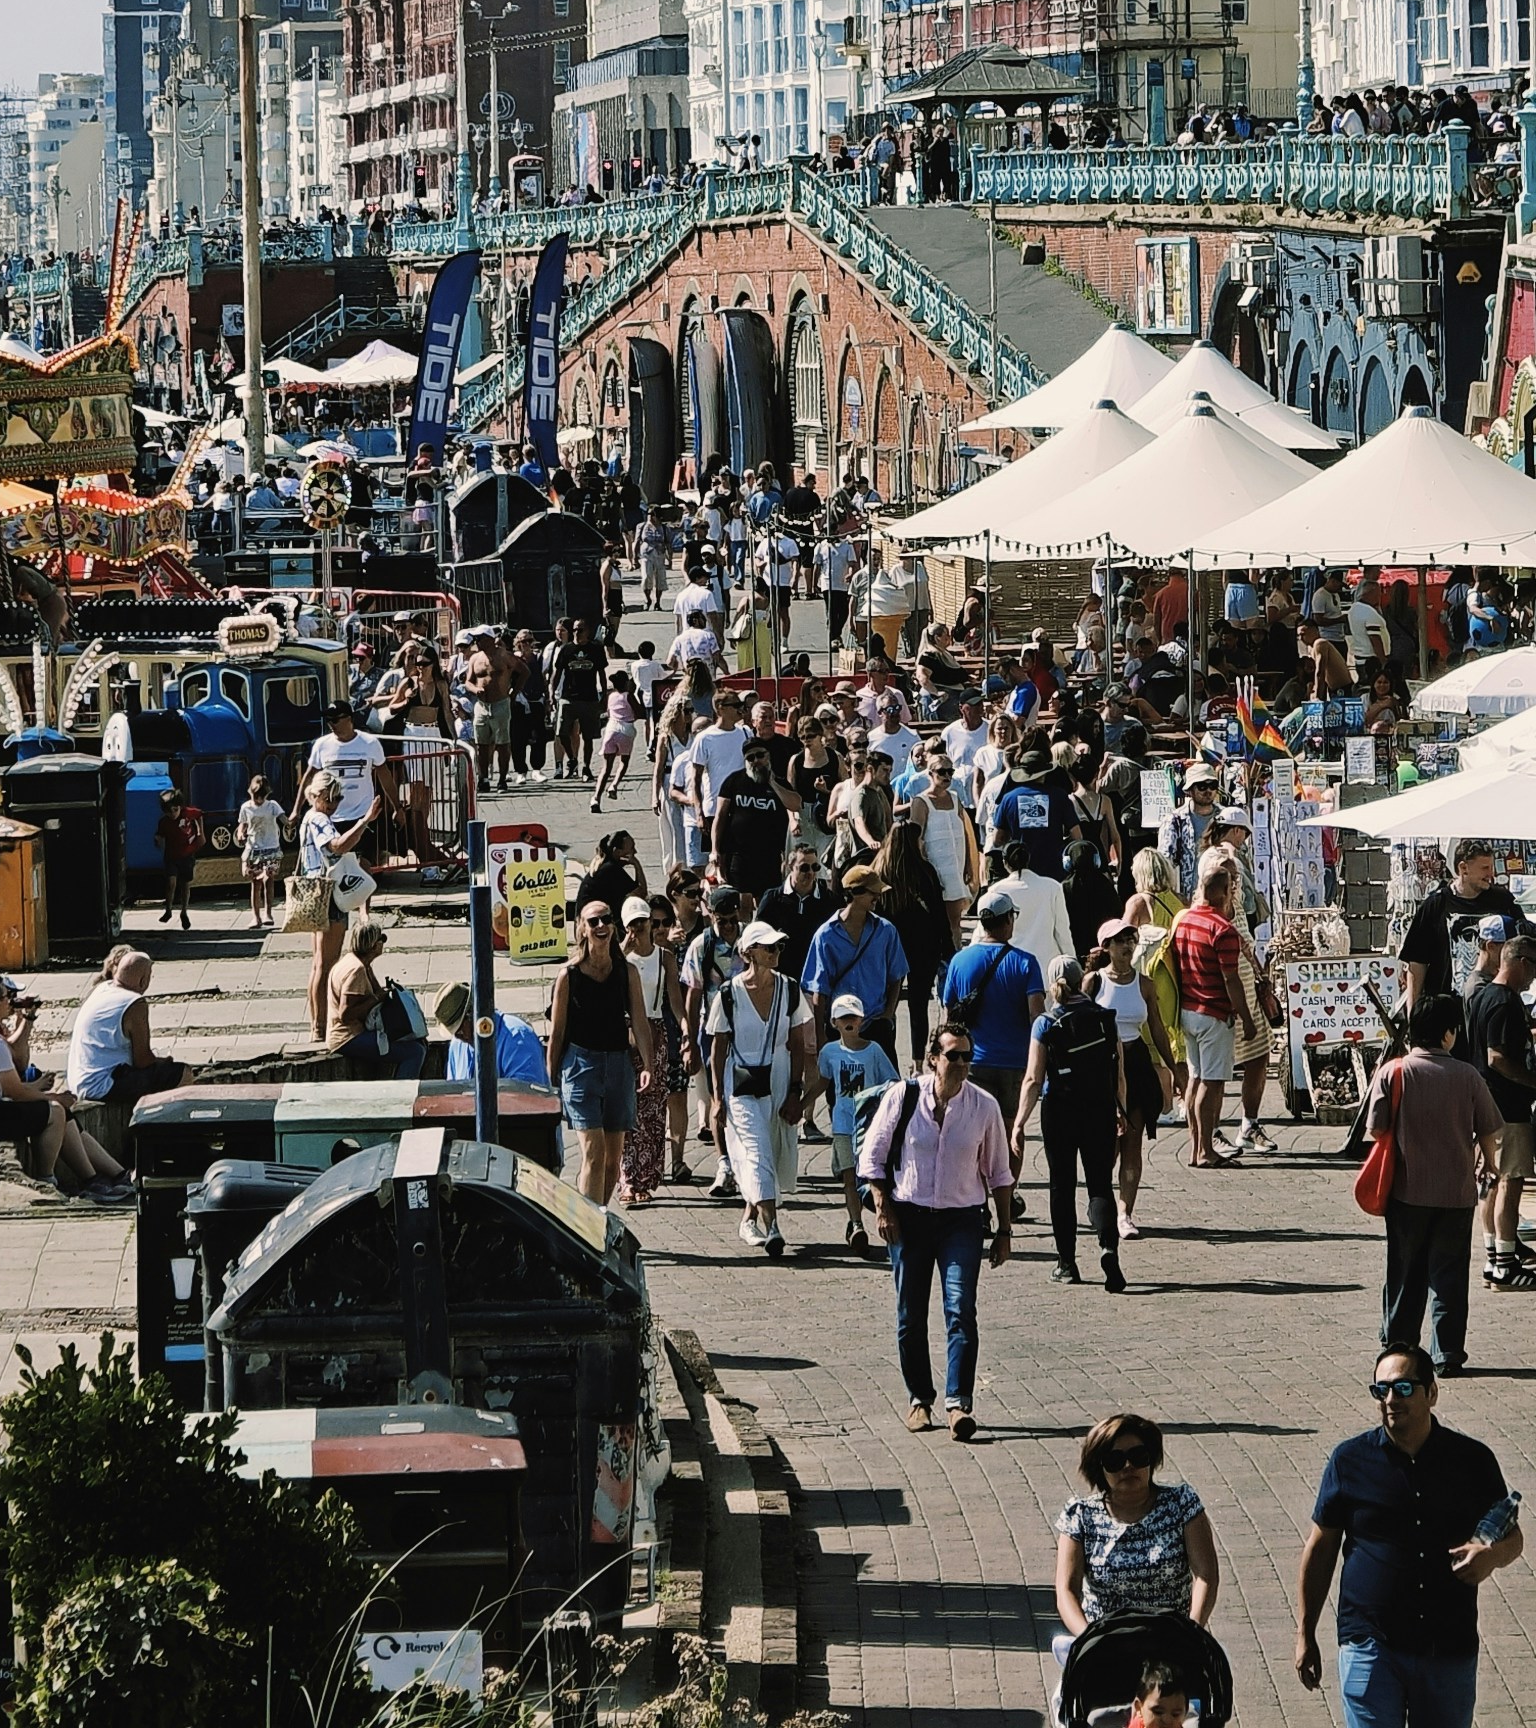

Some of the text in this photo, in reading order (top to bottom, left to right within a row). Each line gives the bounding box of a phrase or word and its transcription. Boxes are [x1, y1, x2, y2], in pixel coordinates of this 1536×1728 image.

[417, 313, 460, 424] TIDE
[530, 301, 556, 422] TIDE
[228, 627, 266, 641] THOMAS
[735, 794, 777, 811] NASA
[513, 868, 557, 891] Wall's
[519, 938, 558, 953] SOLD HERE
[1297, 960, 1382, 982] SHELLS
[1301, 994, 1393, 1006] CASH PREFERED
[1302, 1016, 1383, 1029] CARDS ACCEPTE
